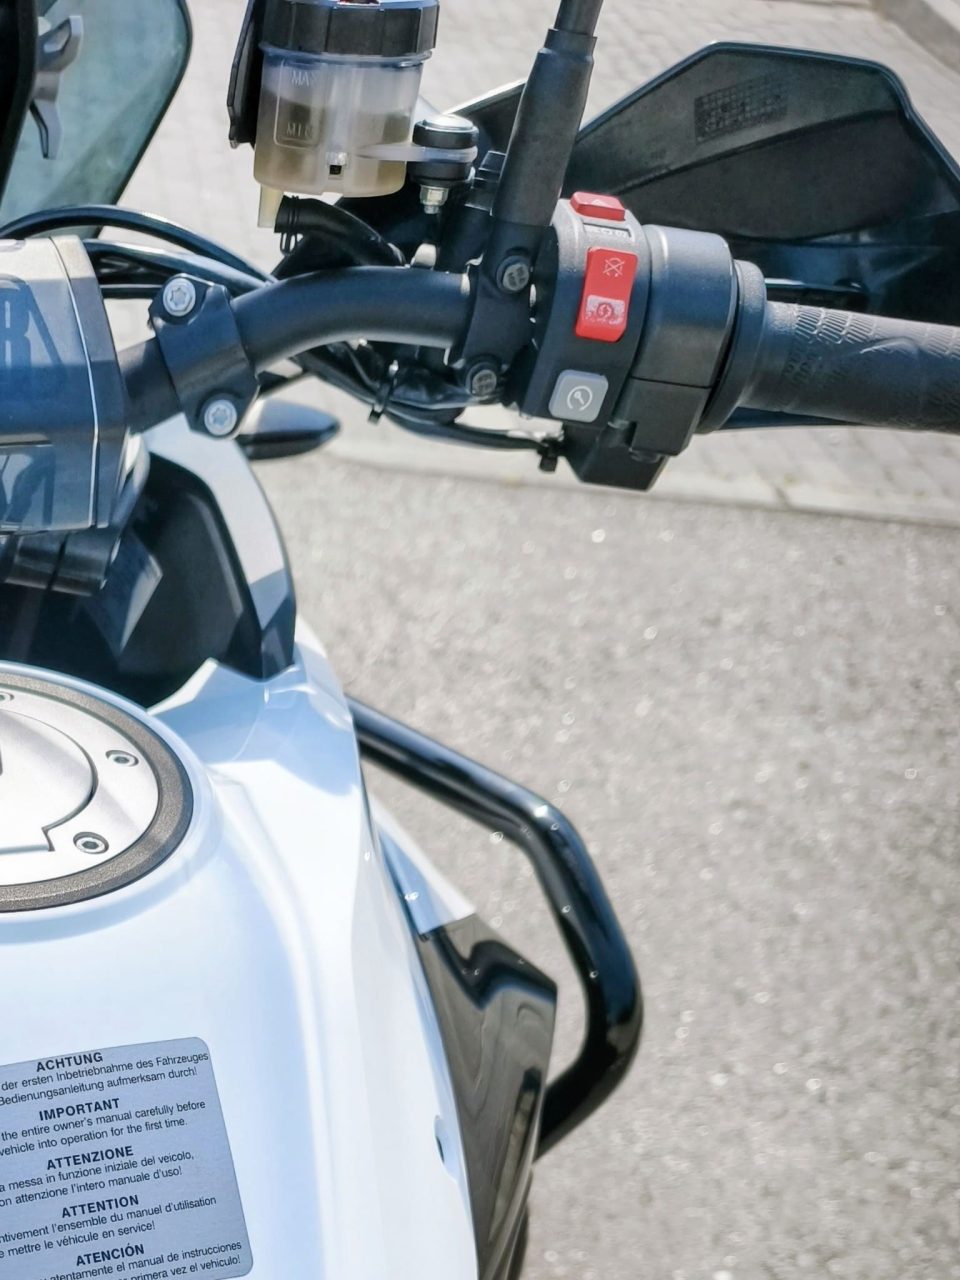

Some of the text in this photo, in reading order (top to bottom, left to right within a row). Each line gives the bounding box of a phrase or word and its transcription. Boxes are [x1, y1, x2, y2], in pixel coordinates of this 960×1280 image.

[1, 1081, 18, 1091] der
[22, 1075, 54, 1087] ersten
[56, 1062, 133, 1081] Inbetriebnahme
[136, 1059, 153, 1069] des
[156, 1053, 209, 1066] Fahrzeuges
[36, 1052, 103, 1073] ACHTUNG
[107, 1073, 165, 1088] aufmerksam
[168, 1066, 198, 1079] durch!
[1, 1131, 18, 1141] the
[21, 1124, 50, 1138] entire
[53, 1117, 93, 1132] owner's
[96, 1110, 132, 1125] manual
[135, 1105, 174, 1119] carefully
[176, 1100, 206, 1112] before
[39, 1098, 120, 1121] IMPORTANT
[38, 1138, 57, 1149] into
[60, 1129, 108, 1146] operation
[111, 1127, 125, 1136] for
[127, 1123, 142, 1134] the
[145, 1120, 162, 1131] first
[165, 1118, 188, 1128] time.
[8, 1179, 43, 1190] messa
[46, 1173, 56, 1183] in
[58, 1166, 102, 1181] funzione
[105, 1159, 138, 1172] iniziale
[141, 1156, 156, 1167] del
[158, 1151, 194, 1164] veicolo,
[47, 1145, 134, 1170] ATTENZIONE
[15, 1187, 68, 1204] attenzione
[71, 1181, 105, 1193] l'intero
[108, 1172, 150, 1187] manuale
[153, 1166, 183, 1179] d'uso!
[51, 1215, 107, 1233] l'ensemble
[110, 1212, 123, 1223] du
[126, 1205, 162, 1219] manuel
[165, 1197, 216, 1213] d'utilisation
[61, 1194, 139, 1218] ATTENTION
[7, 1243, 41, 1257] mettre
[44, 1240, 54, 1249] le
[56, 1231, 99, 1247] véhicule
[102, 1229, 115, 1239] en
[118, 1221, 155, 1236] service!
[76, 1243, 145, 1266] ATENCIÓN
[116, 1261, 126, 1272] el
[128, 1254, 165, 1270] manual
[167, 1252, 179, 1263] de
[182, 1241, 242, 1259] instrucciones
[170, 1265, 186, 1276] vez
[189, 1261, 198, 1273] el
